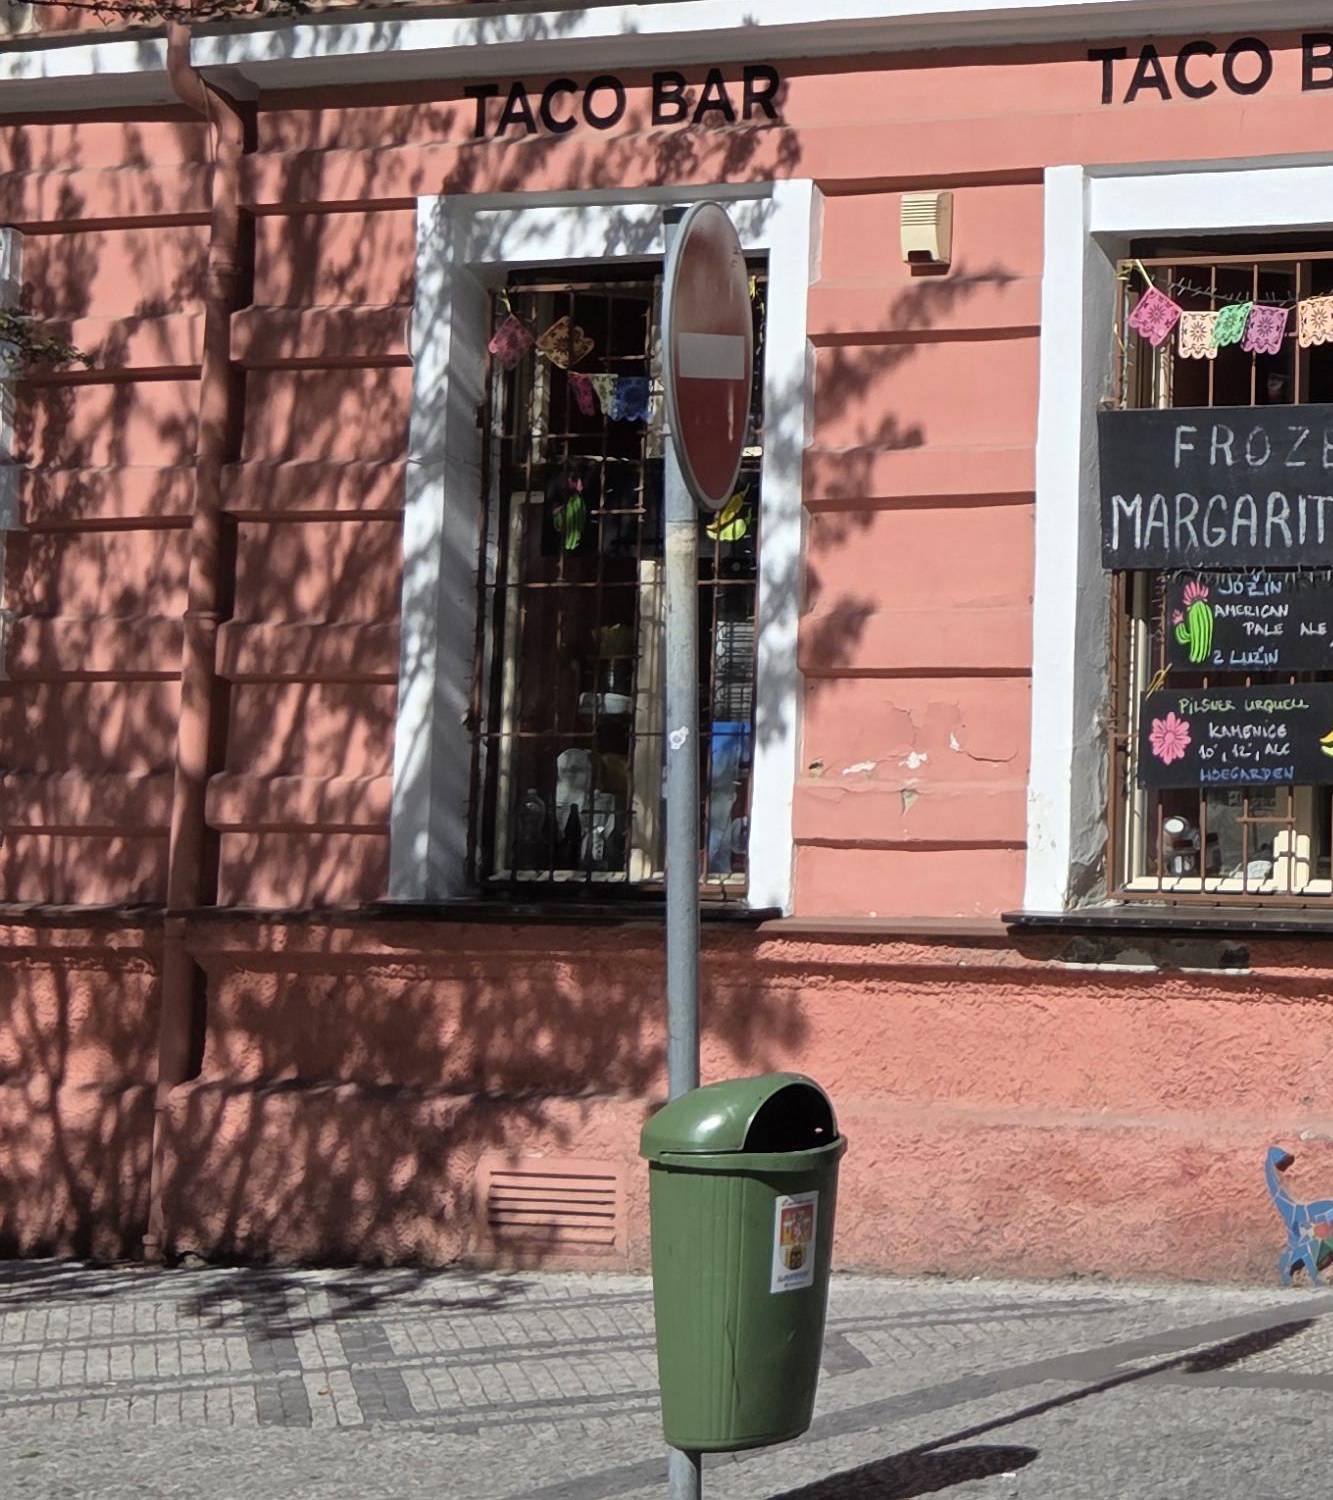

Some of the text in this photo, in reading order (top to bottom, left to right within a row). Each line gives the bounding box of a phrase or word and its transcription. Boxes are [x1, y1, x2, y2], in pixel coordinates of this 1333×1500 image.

[1087, 37, 1273, 105] TACO
[464, 65, 780, 138] TACO BAR
[1213, 603, 1289, 619] AMERICAN
[1242, 620, 1284, 636] PALE
[1299, 622, 1327, 636] ALE
